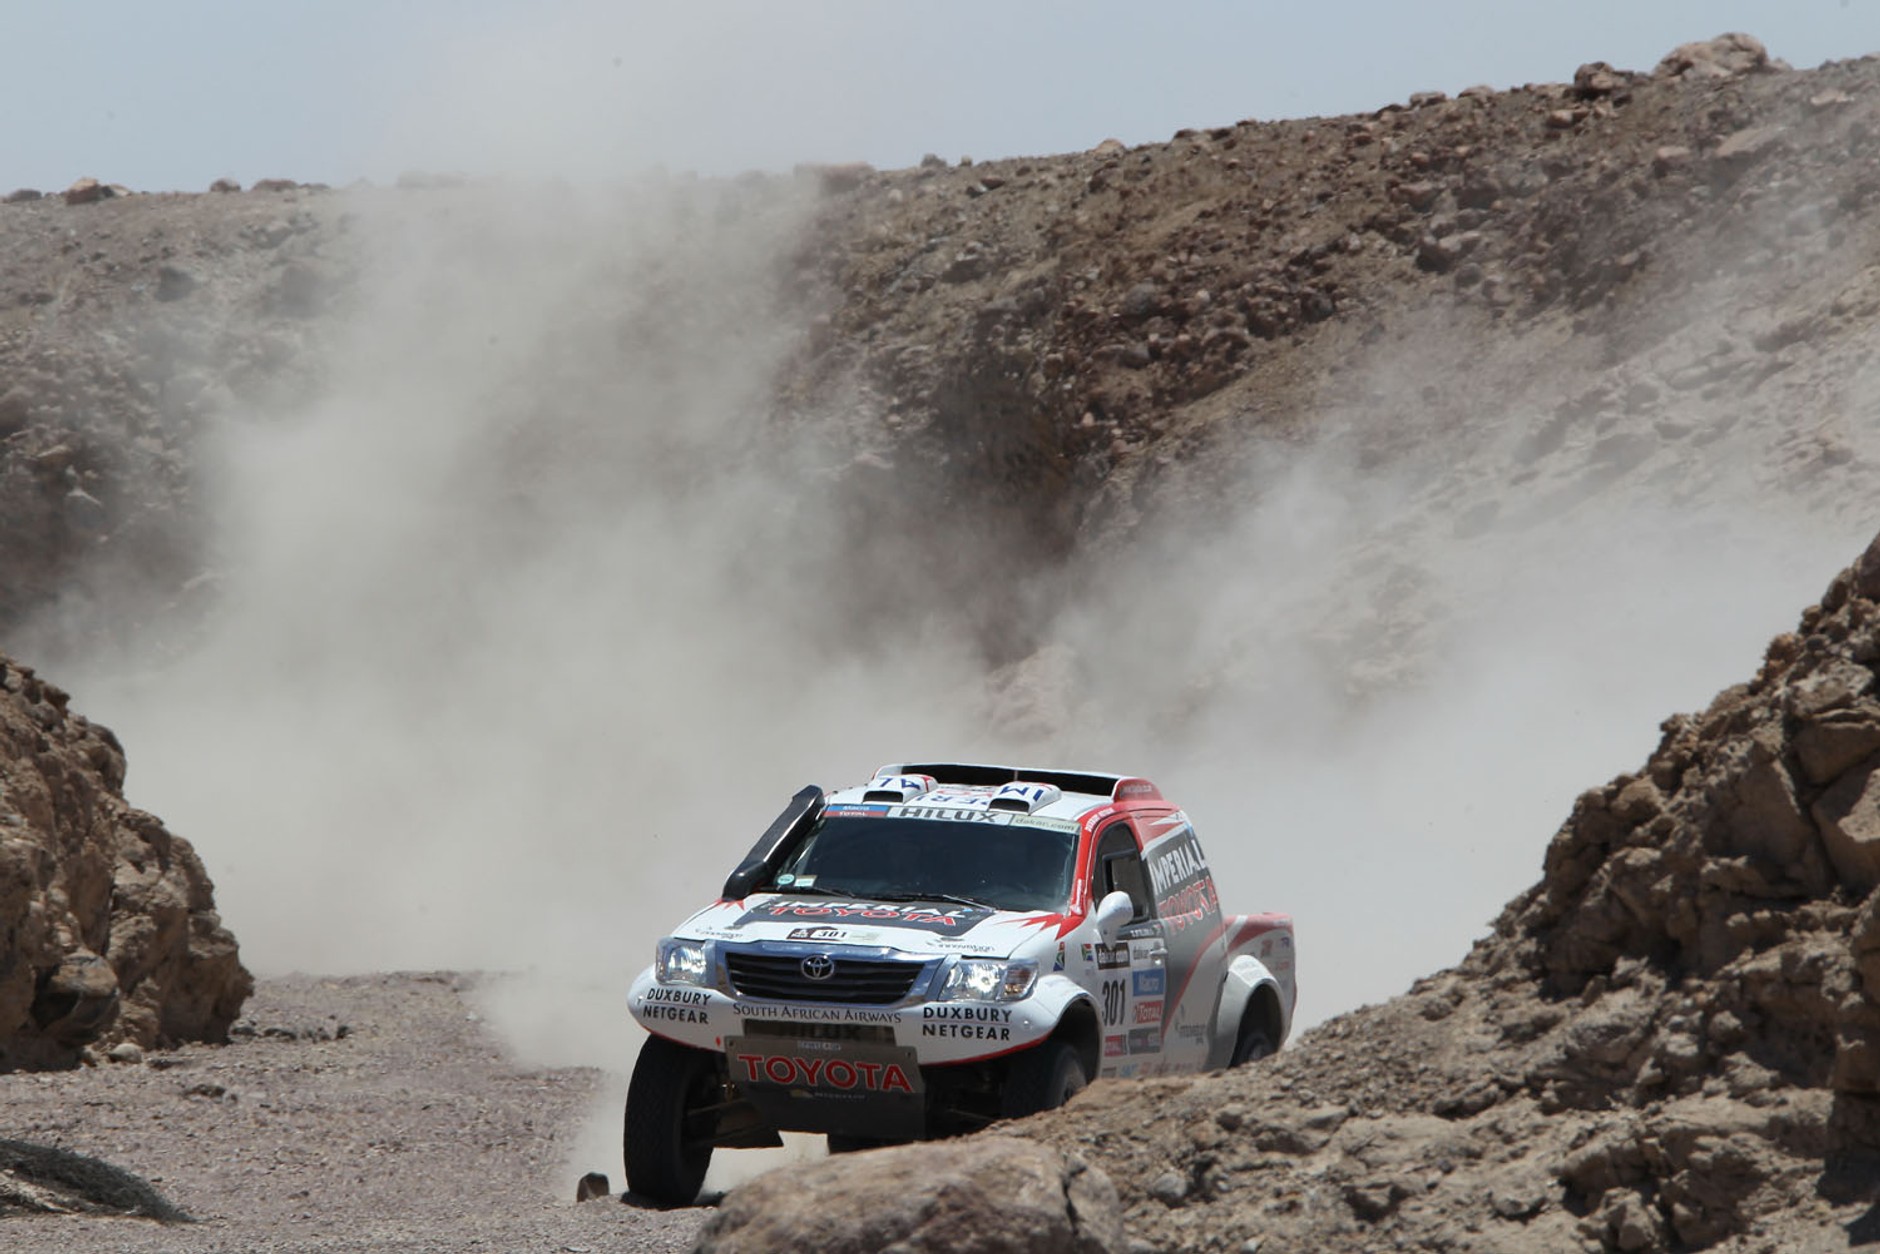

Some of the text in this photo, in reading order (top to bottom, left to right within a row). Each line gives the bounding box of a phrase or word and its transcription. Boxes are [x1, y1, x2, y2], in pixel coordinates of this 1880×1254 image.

[900, 807, 998, 823] HILUX
[1148, 839, 1207, 895] IMPERIAL
[768, 905, 957, 926] TOYOTA
[1157, 876, 1218, 936] TOYOTA
[817, 930, 848, 938] 301
[646, 988, 711, 1006] DUXBURY
[1101, 978, 1126, 1027] 301
[642, 1005, 709, 1024] NETGEAR
[733, 1003, 902, 1023] SOUTH AFRICAN AIRWAYS
[923, 1007, 1013, 1023] DUXBURY
[1139, 1004, 1161, 1021] TOTAL
[922, 1023, 1010, 1041] NETGEAR
[737, 1054, 914, 1093] TOYOTA
